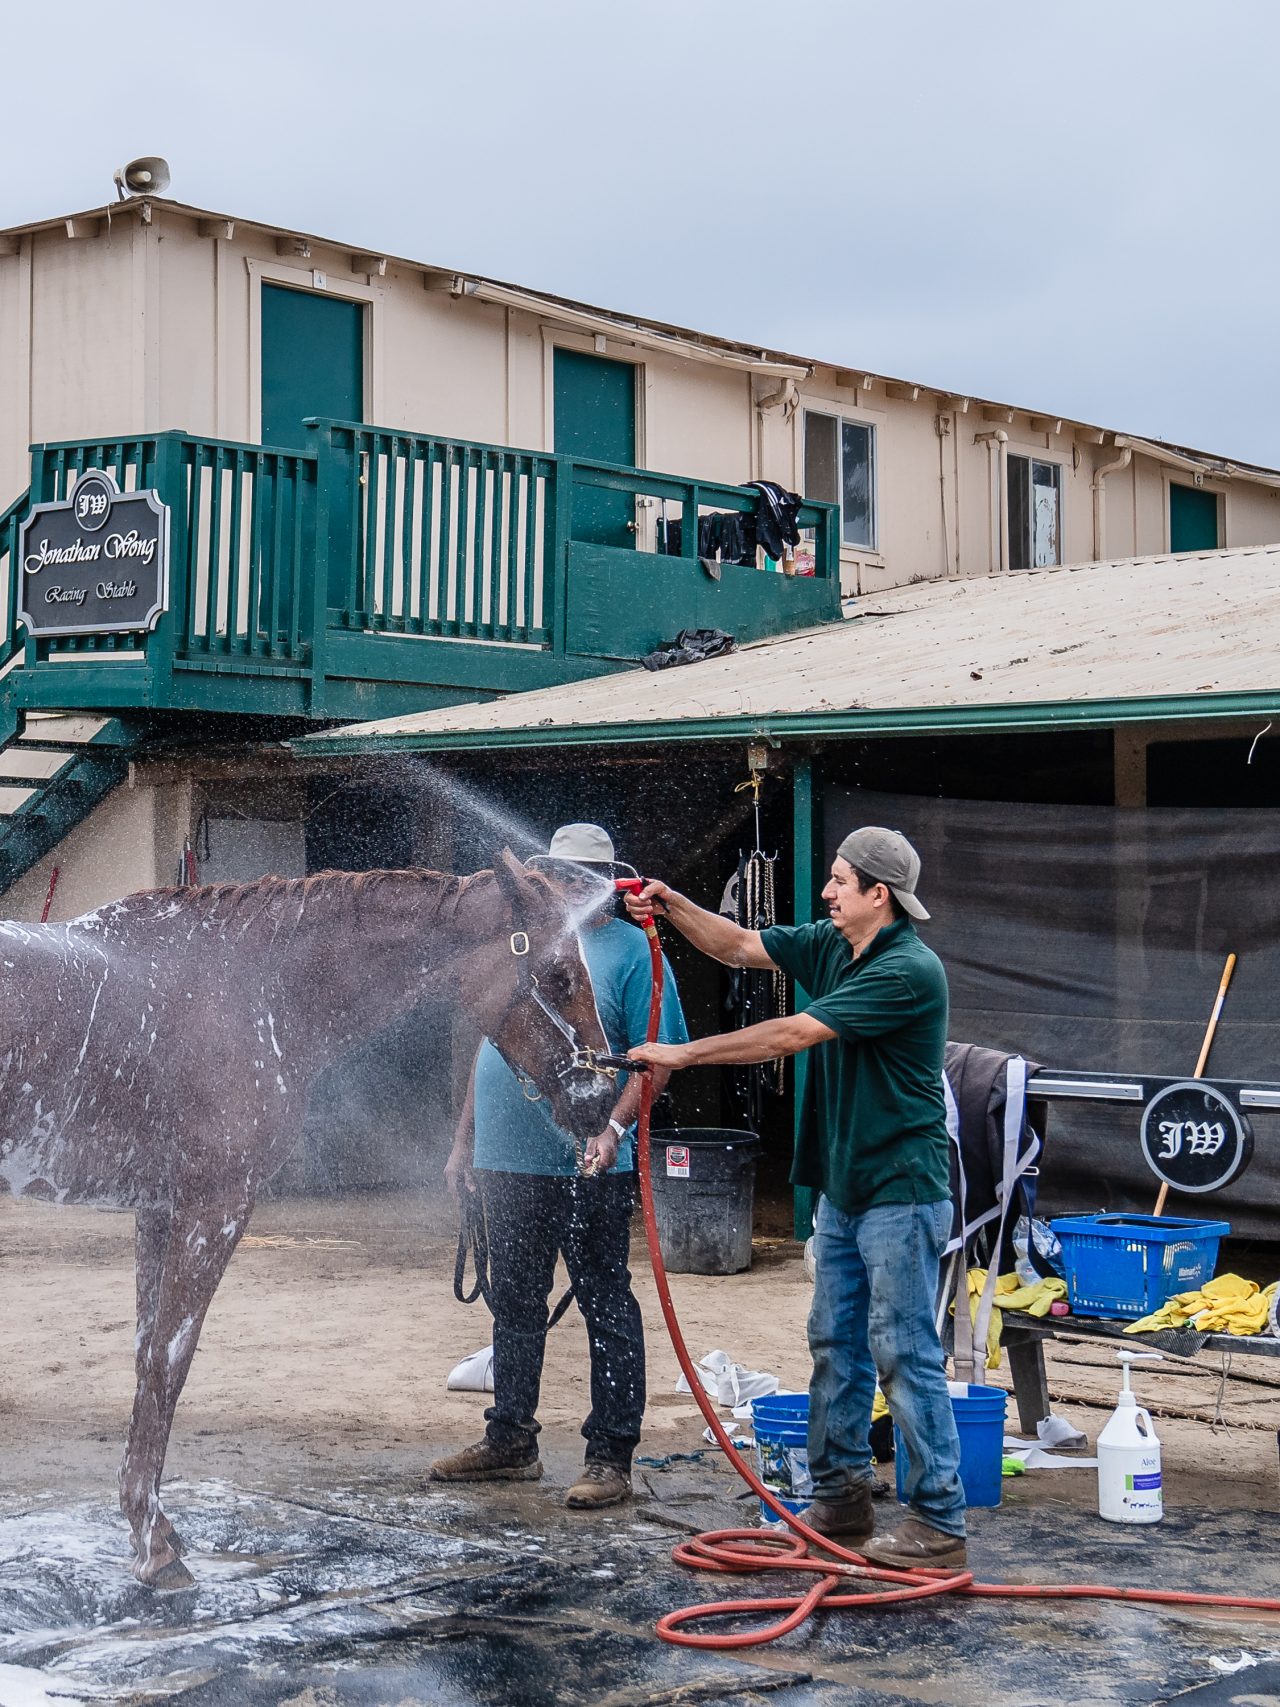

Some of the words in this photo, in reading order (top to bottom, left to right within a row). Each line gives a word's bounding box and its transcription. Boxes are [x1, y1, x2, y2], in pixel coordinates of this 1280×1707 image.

[78, 494, 107, 517] JW
[24, 538, 101, 574] Jonathan
[104, 529, 158, 565] Wong
[44, 585, 87, 606] Racing
[95, 580, 136, 599] Stable
[1158, 1121, 1225, 1158] JW
